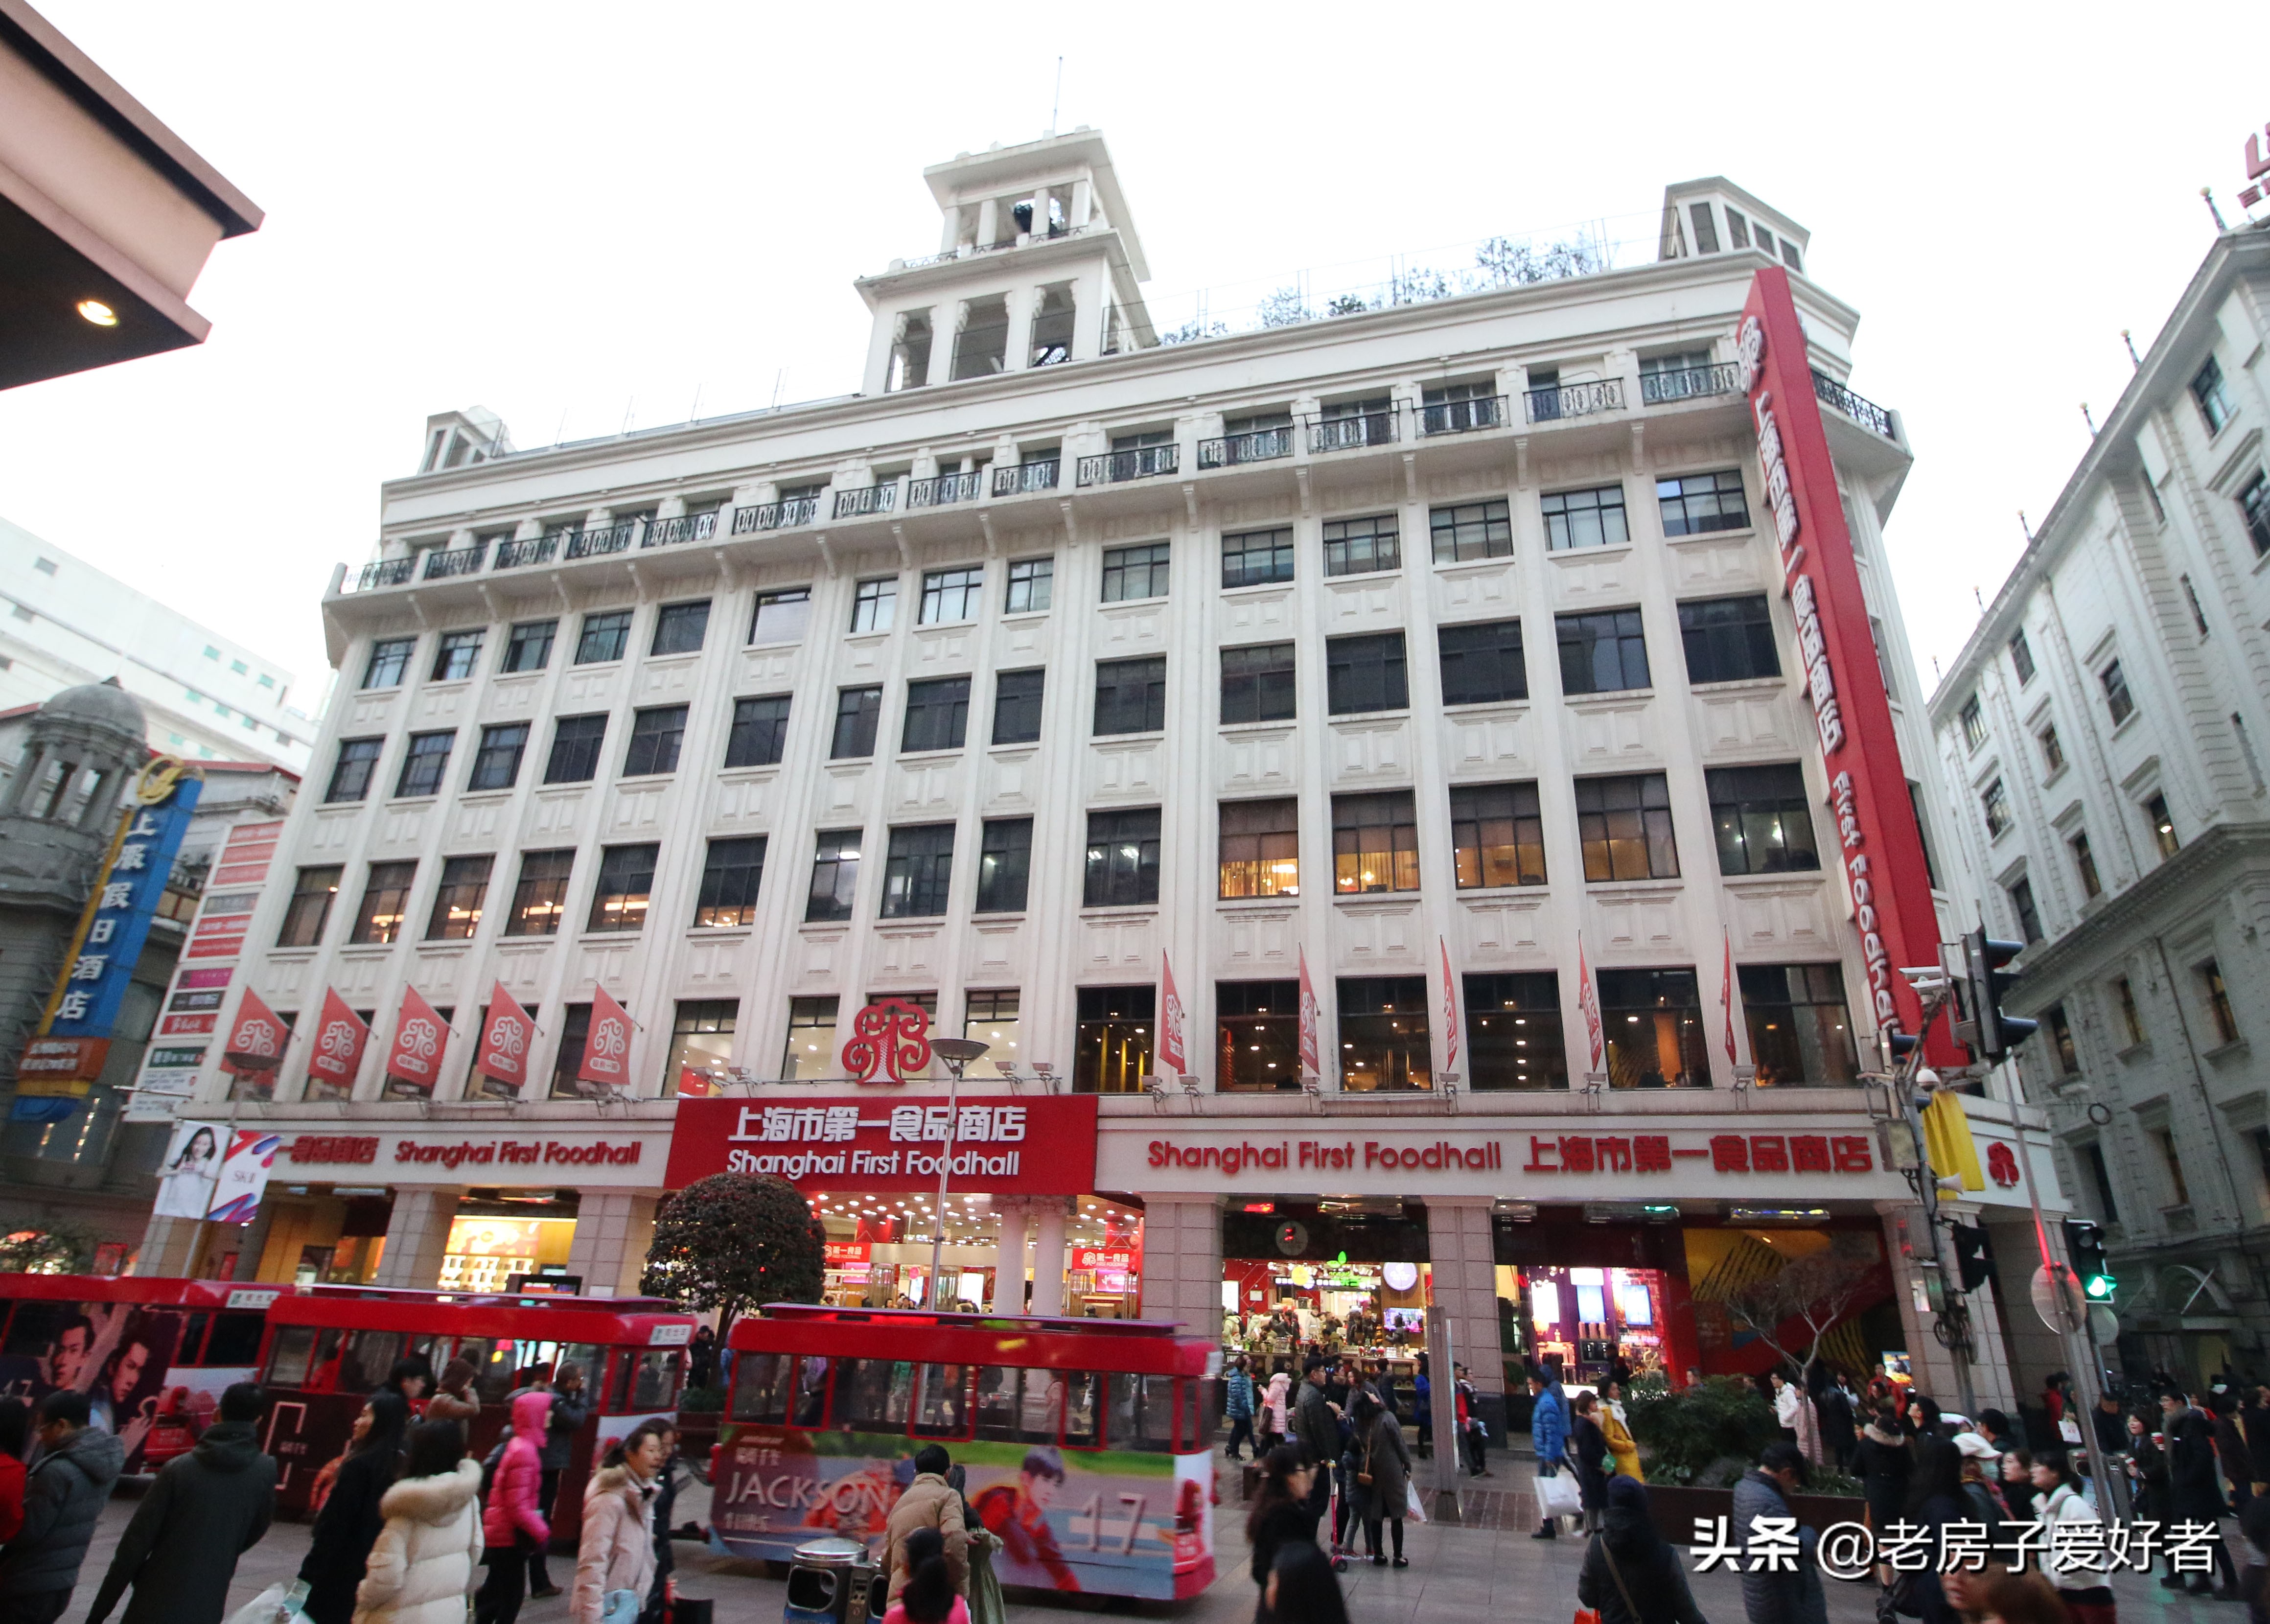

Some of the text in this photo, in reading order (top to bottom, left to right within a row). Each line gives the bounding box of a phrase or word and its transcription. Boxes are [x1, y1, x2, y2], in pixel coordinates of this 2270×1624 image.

[1832, 770, 1860, 848] First
[55, 812, 156, 1020] 上服假日酒店
[728, 1105, 1027, 1143] 上海市第一食品商店
[395, 1141, 643, 1169] Shanghai First Foodhall
[727, 1149, 1020, 1181] Shanghai First Foodhall
[1148, 1140, 1502, 1175] Shanghai First Foodhall
[1523, 1135, 1874, 1173] 上海市第一食品商店
[725, 1471, 891, 1515] JACKSON
[1080, 1490, 1148, 1556] 17
